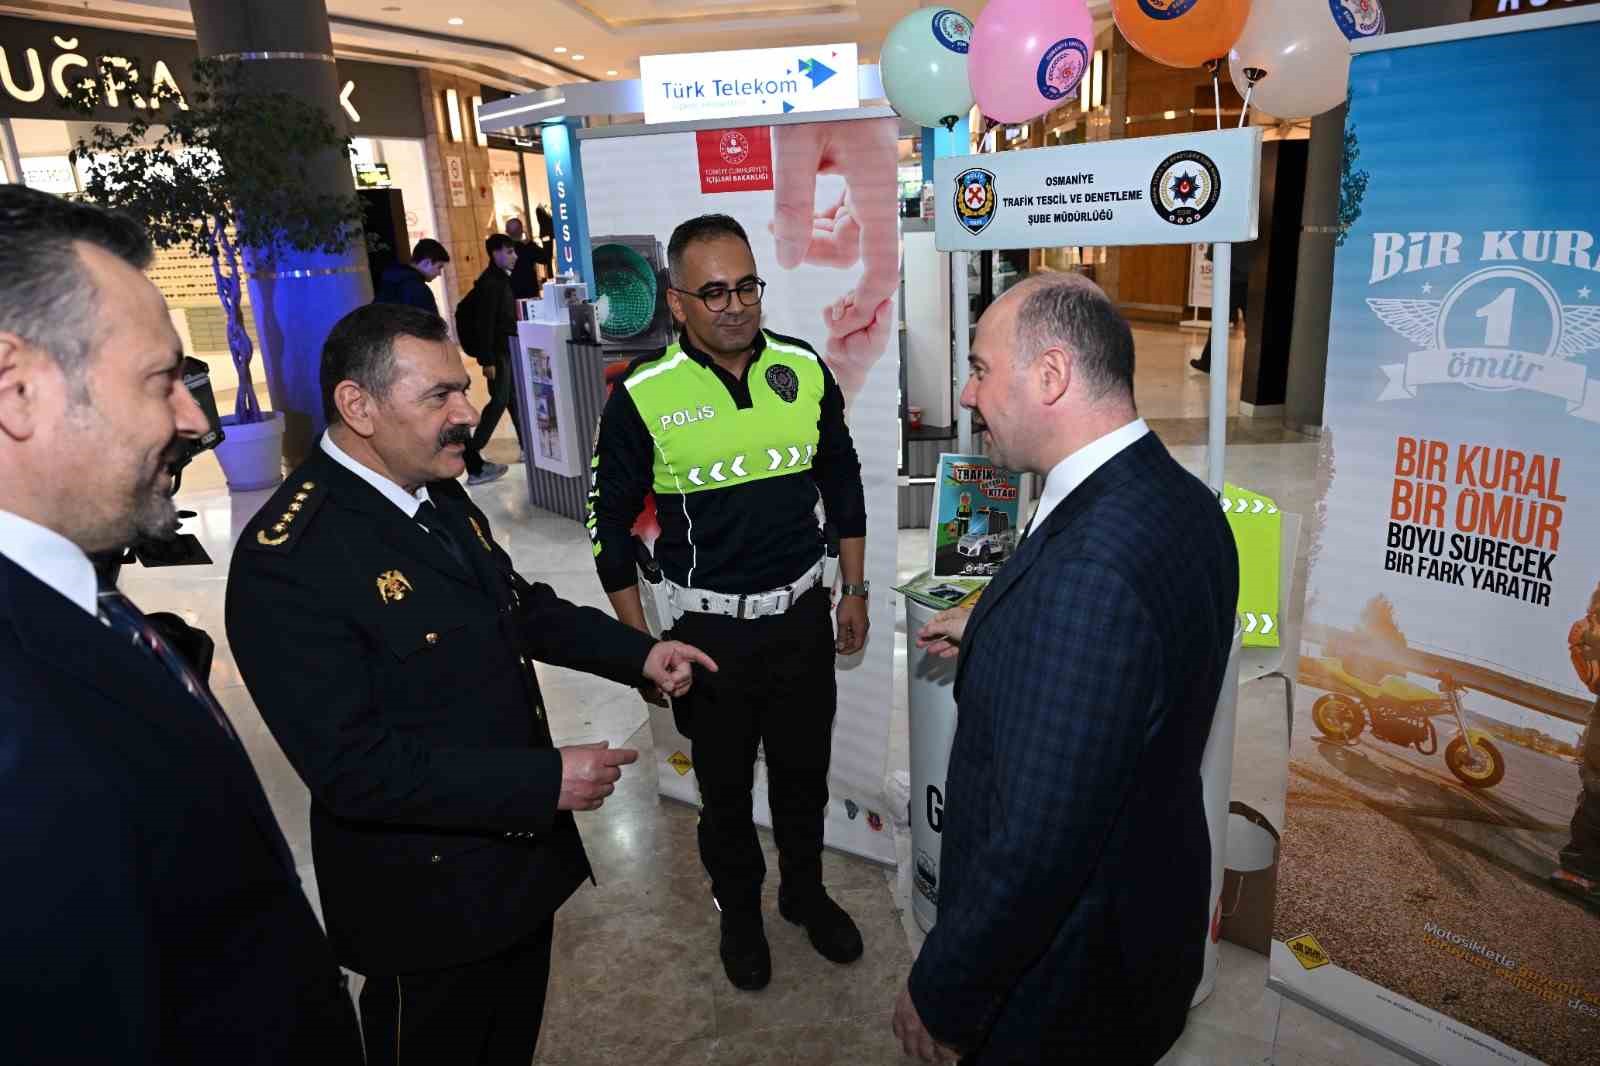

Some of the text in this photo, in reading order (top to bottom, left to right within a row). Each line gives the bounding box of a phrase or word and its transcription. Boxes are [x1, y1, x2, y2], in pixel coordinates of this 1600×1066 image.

[662, 78, 798, 99] Türk Telekom
[1046, 173, 1094, 187] OSMANİYE
[1003, 190, 1143, 207] TRAFİK TESCİL VE DENETLEME
[1028, 208, 1113, 226] ŞUBE MÜDÜRLÜĞÜ
[1475, 287, 1516, 346] 1
[1448, 351, 1543, 383] ömür
[1455, 444, 1567, 502] KURAL
[1455, 487, 1563, 552] ÖMÜR
[1387, 522, 1445, 557] BOYU
[1417, 556, 1465, 586] FARK
[1471, 566, 1551, 607] YARATIR
